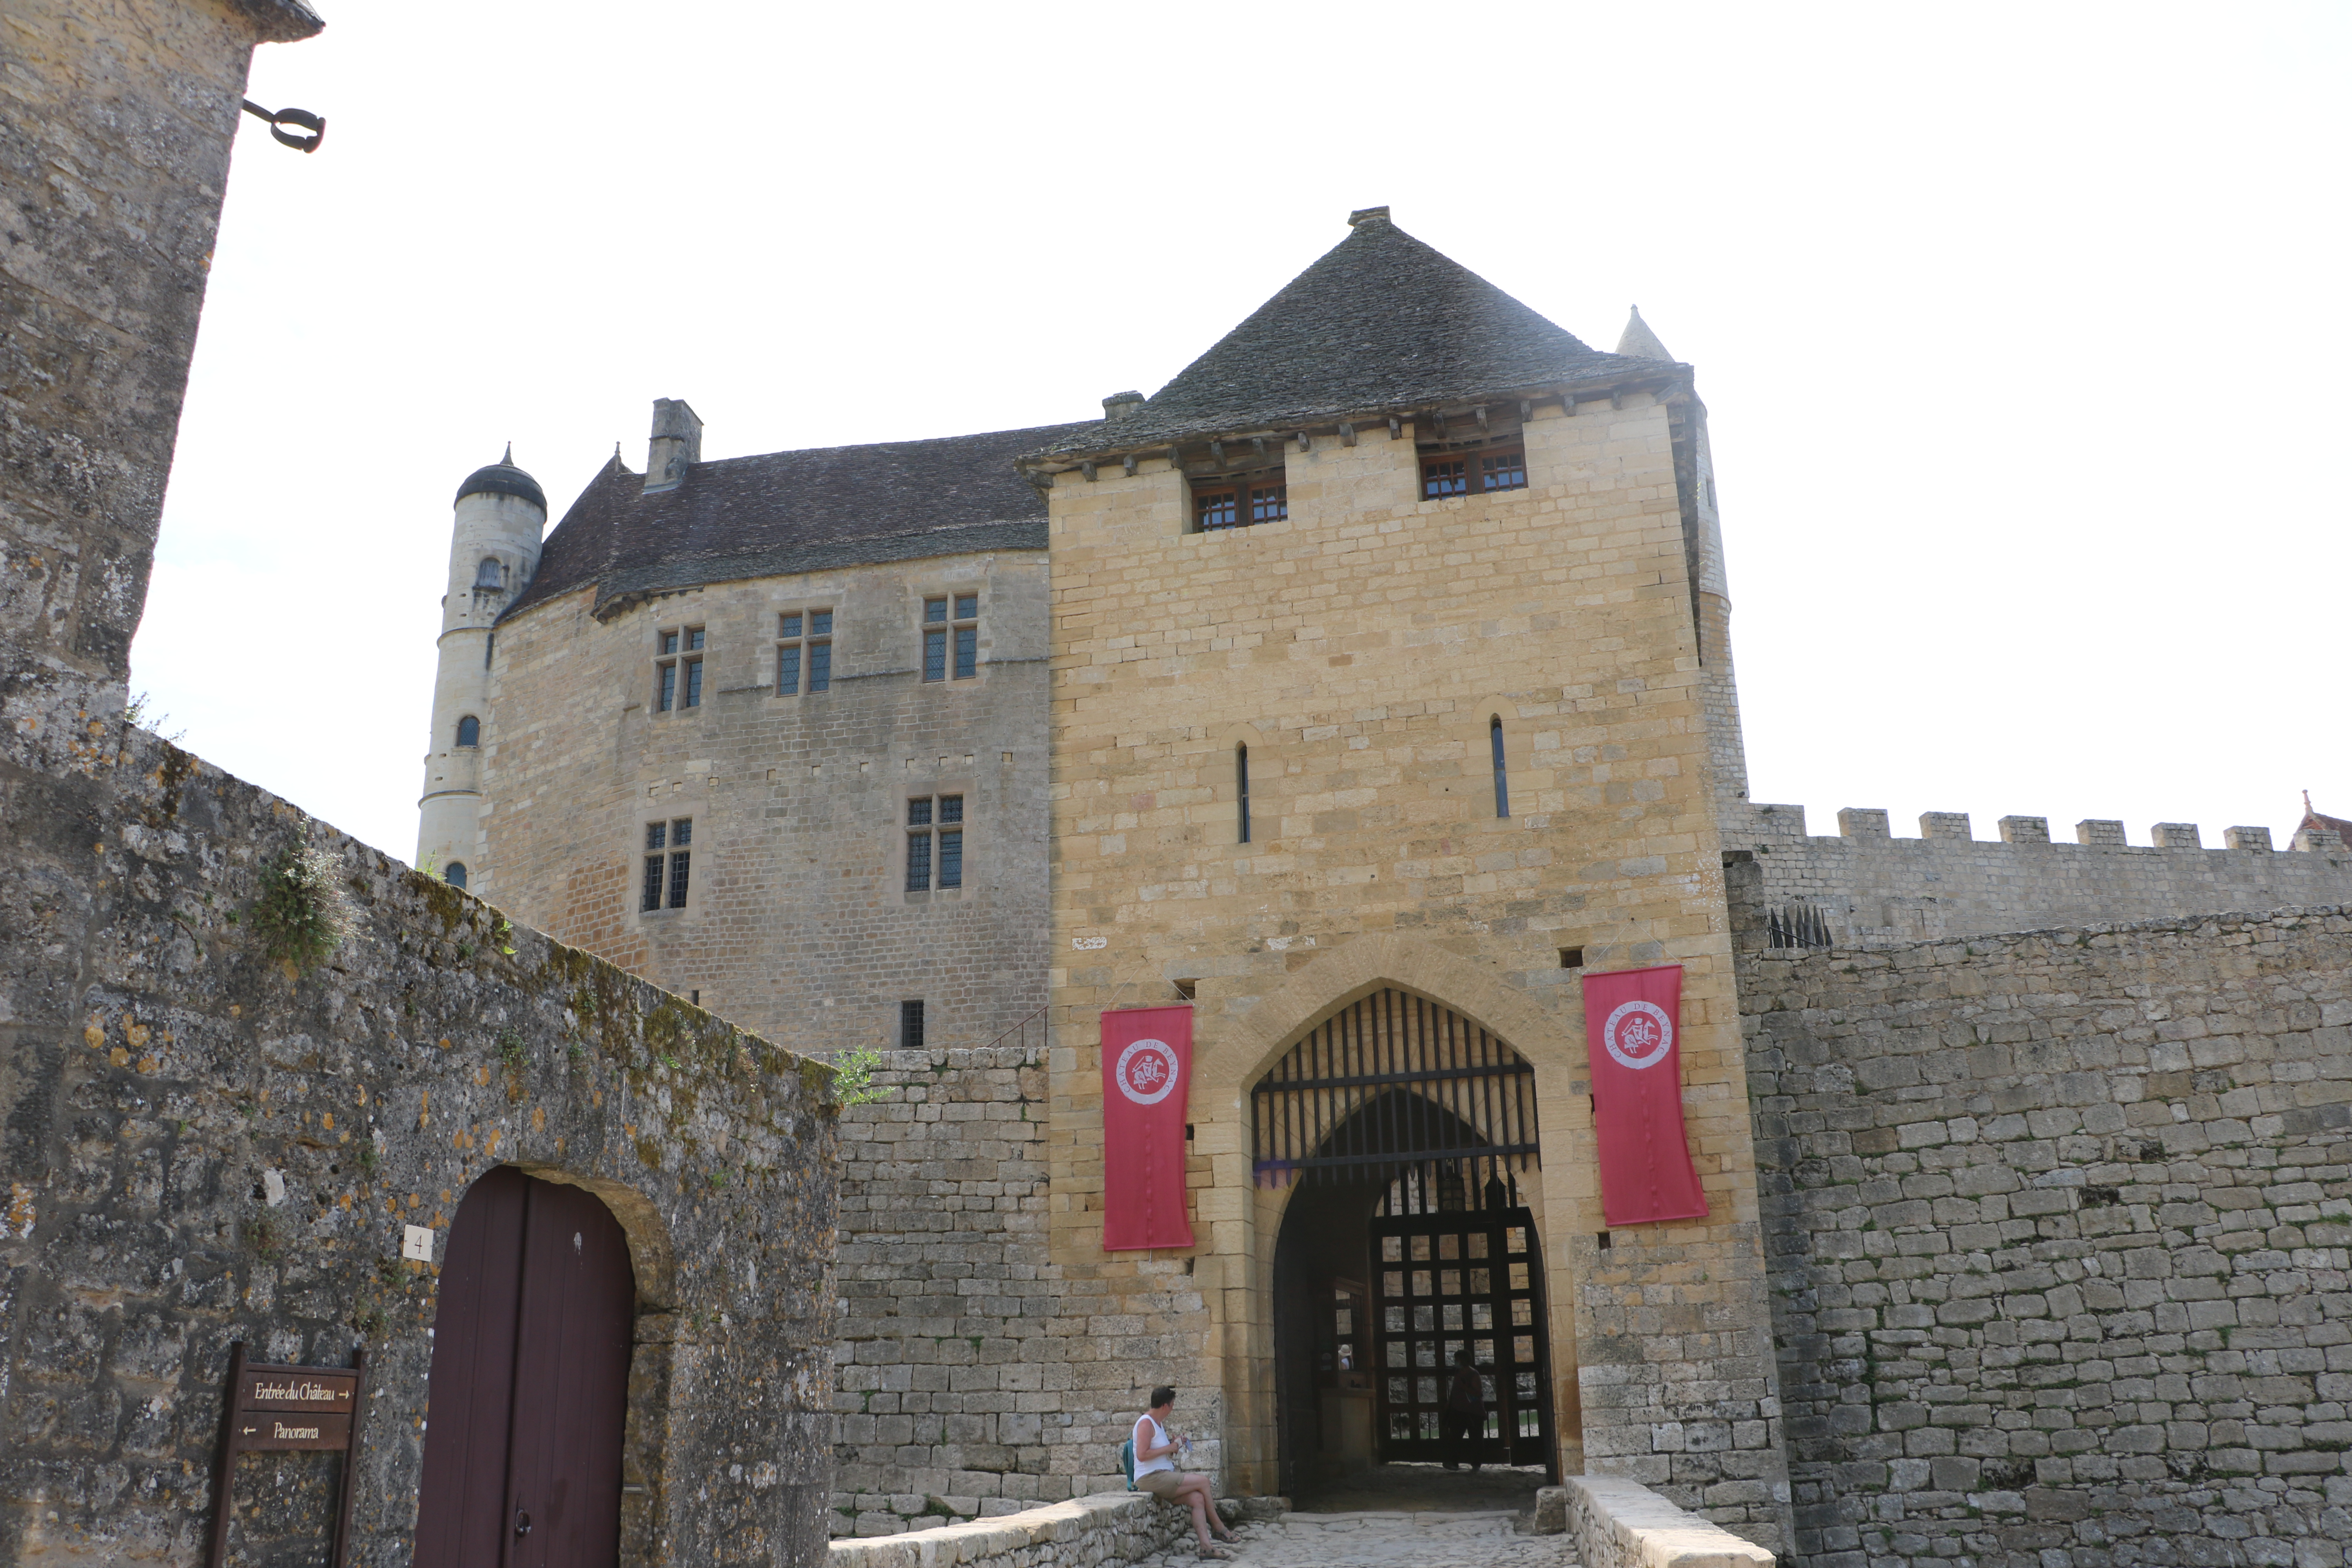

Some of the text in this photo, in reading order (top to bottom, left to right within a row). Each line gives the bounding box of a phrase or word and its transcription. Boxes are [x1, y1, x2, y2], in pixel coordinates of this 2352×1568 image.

[1607, 1007, 1626, 1058] CHATEAU
[1653, 1009, 1670, 1054] BEYNAC
[1119, 1044, 1138, 1093] CHATEAU
[1163, 1048, 1176, 1092] BEYNAC
[414, 1234, 422, 1254] 4
[255, 1380, 334, 1401] Entrée du Château
[274, 1422, 318, 1439] Panorama
